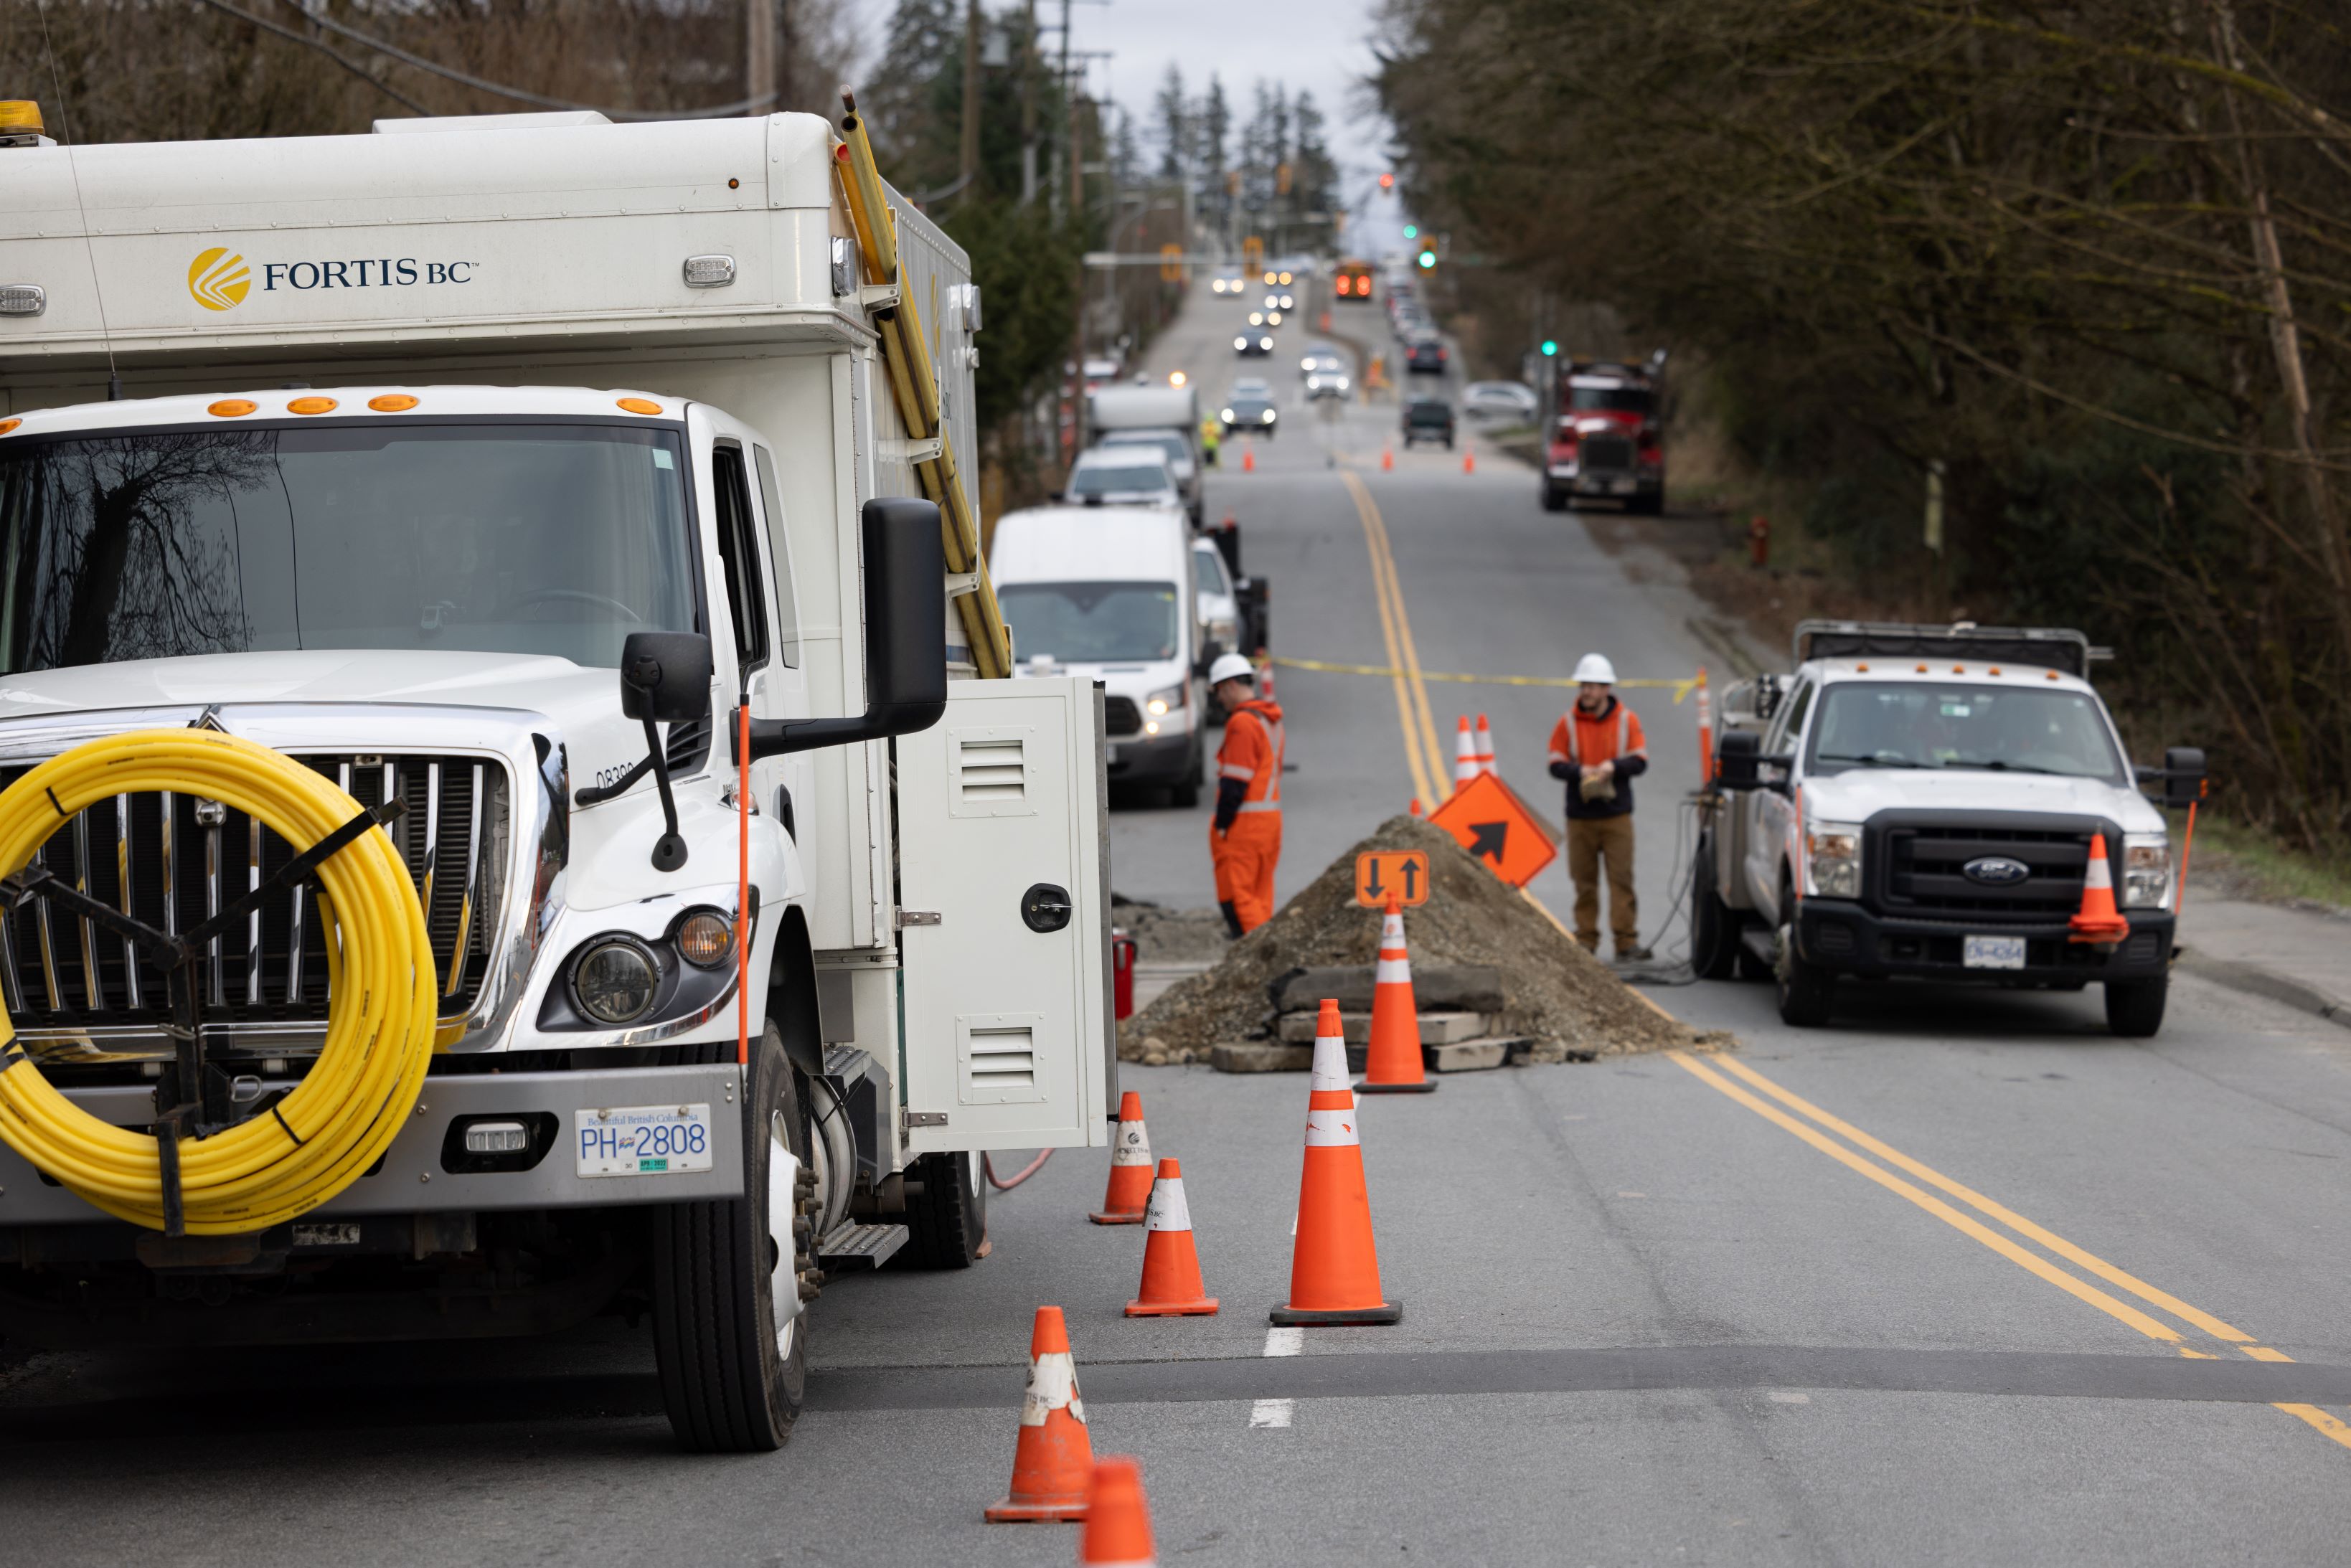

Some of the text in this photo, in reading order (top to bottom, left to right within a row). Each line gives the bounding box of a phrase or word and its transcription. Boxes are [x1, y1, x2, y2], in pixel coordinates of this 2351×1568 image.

[263, 258, 418, 291] FORTIS
[628, 1114, 655, 1125] British
[656, 1113, 698, 1123] Columbia
[580, 1124, 705, 1159] PH 2808
